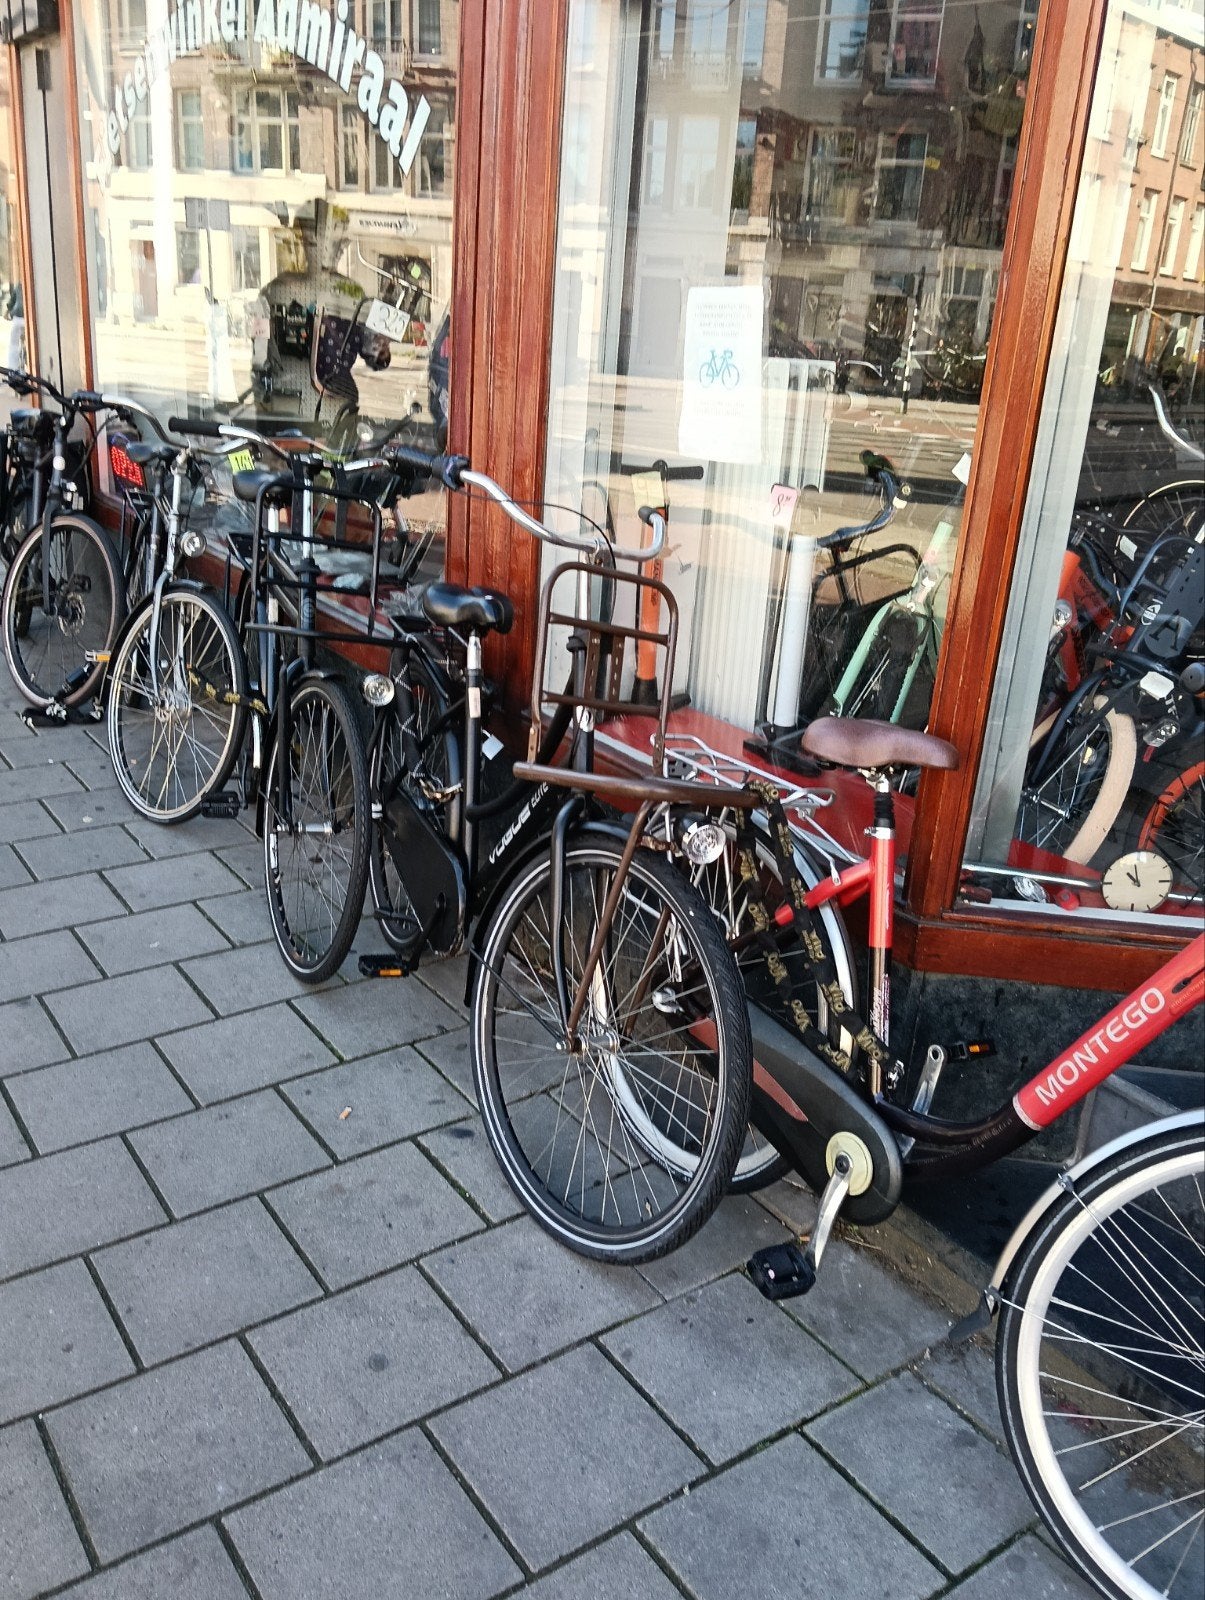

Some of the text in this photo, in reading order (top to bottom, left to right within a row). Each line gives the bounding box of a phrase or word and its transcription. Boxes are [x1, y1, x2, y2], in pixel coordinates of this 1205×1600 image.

[254, 0, 431, 177] Admiraal
[488, 801, 531, 865] VOGUE
[1034, 987, 1166, 1107] MONTEGO
